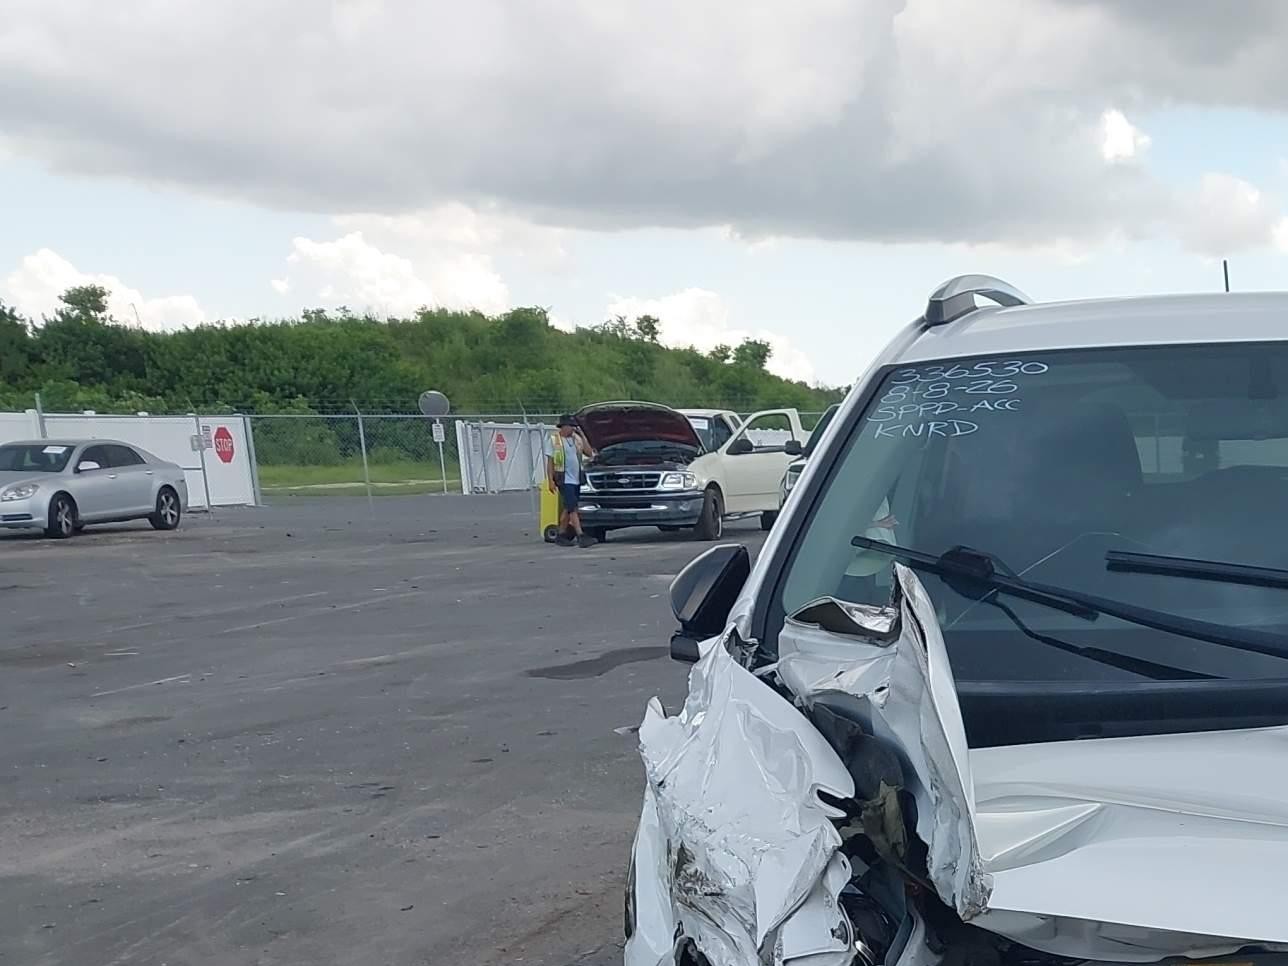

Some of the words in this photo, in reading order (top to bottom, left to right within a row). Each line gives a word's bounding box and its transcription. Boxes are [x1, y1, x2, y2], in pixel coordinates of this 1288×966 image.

[891, 360, 1049, 384] 336530
[880, 379, 1019, 404] 8-8-26
[873, 418, 979, 441] KNRD
[215, 438, 232, 452] STOP
